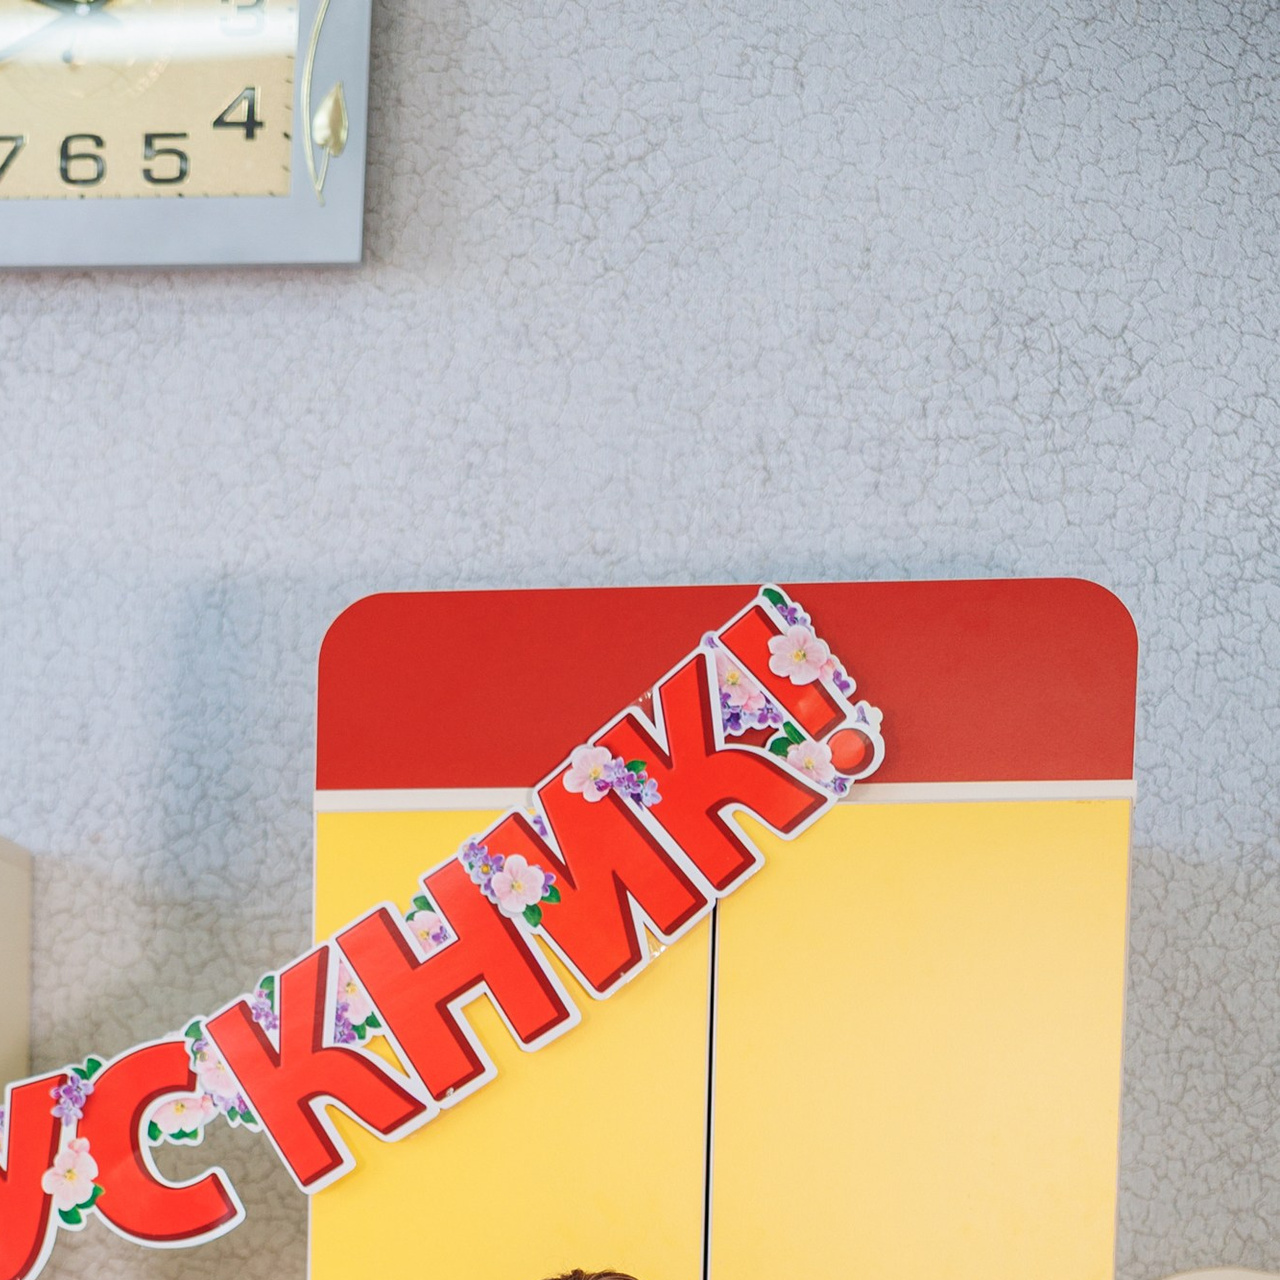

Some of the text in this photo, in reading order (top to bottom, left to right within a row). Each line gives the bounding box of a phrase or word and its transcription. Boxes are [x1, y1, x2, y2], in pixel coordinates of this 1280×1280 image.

[212, 86, 264, 141] 4
[58, 133, 107, 188] 6
[141, 132, 190, 187] 5
